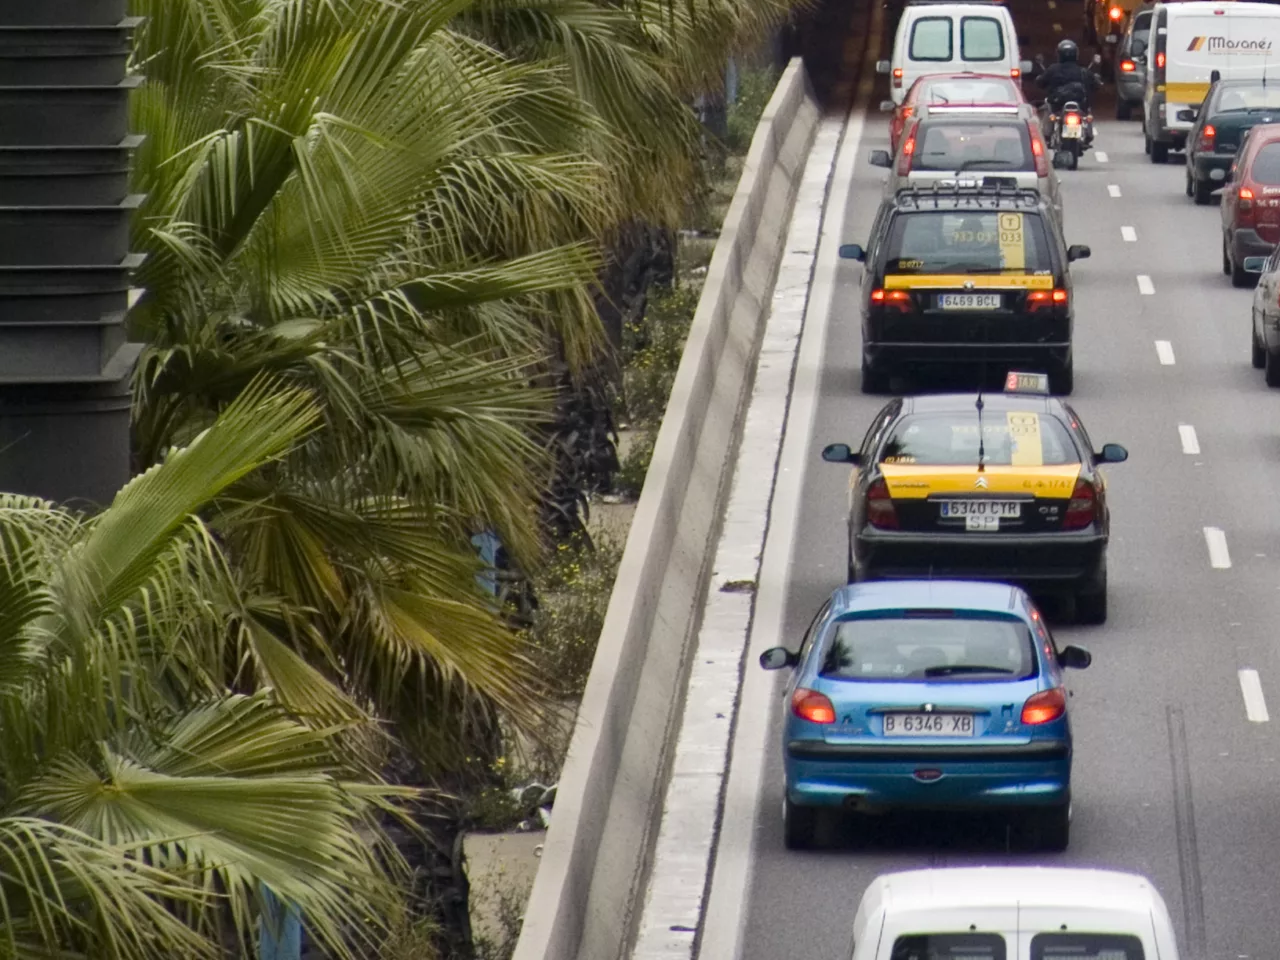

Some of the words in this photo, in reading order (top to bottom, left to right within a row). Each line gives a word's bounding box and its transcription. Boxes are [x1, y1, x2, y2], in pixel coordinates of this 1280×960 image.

[1001, 232, 1021, 242] 033
[944, 295, 973, 307] 6469
[976, 295, 998, 307] BCL
[951, 501, 986, 515] 6340
[990, 501, 1017, 515] CYR
[904, 715, 943, 731] 6346
